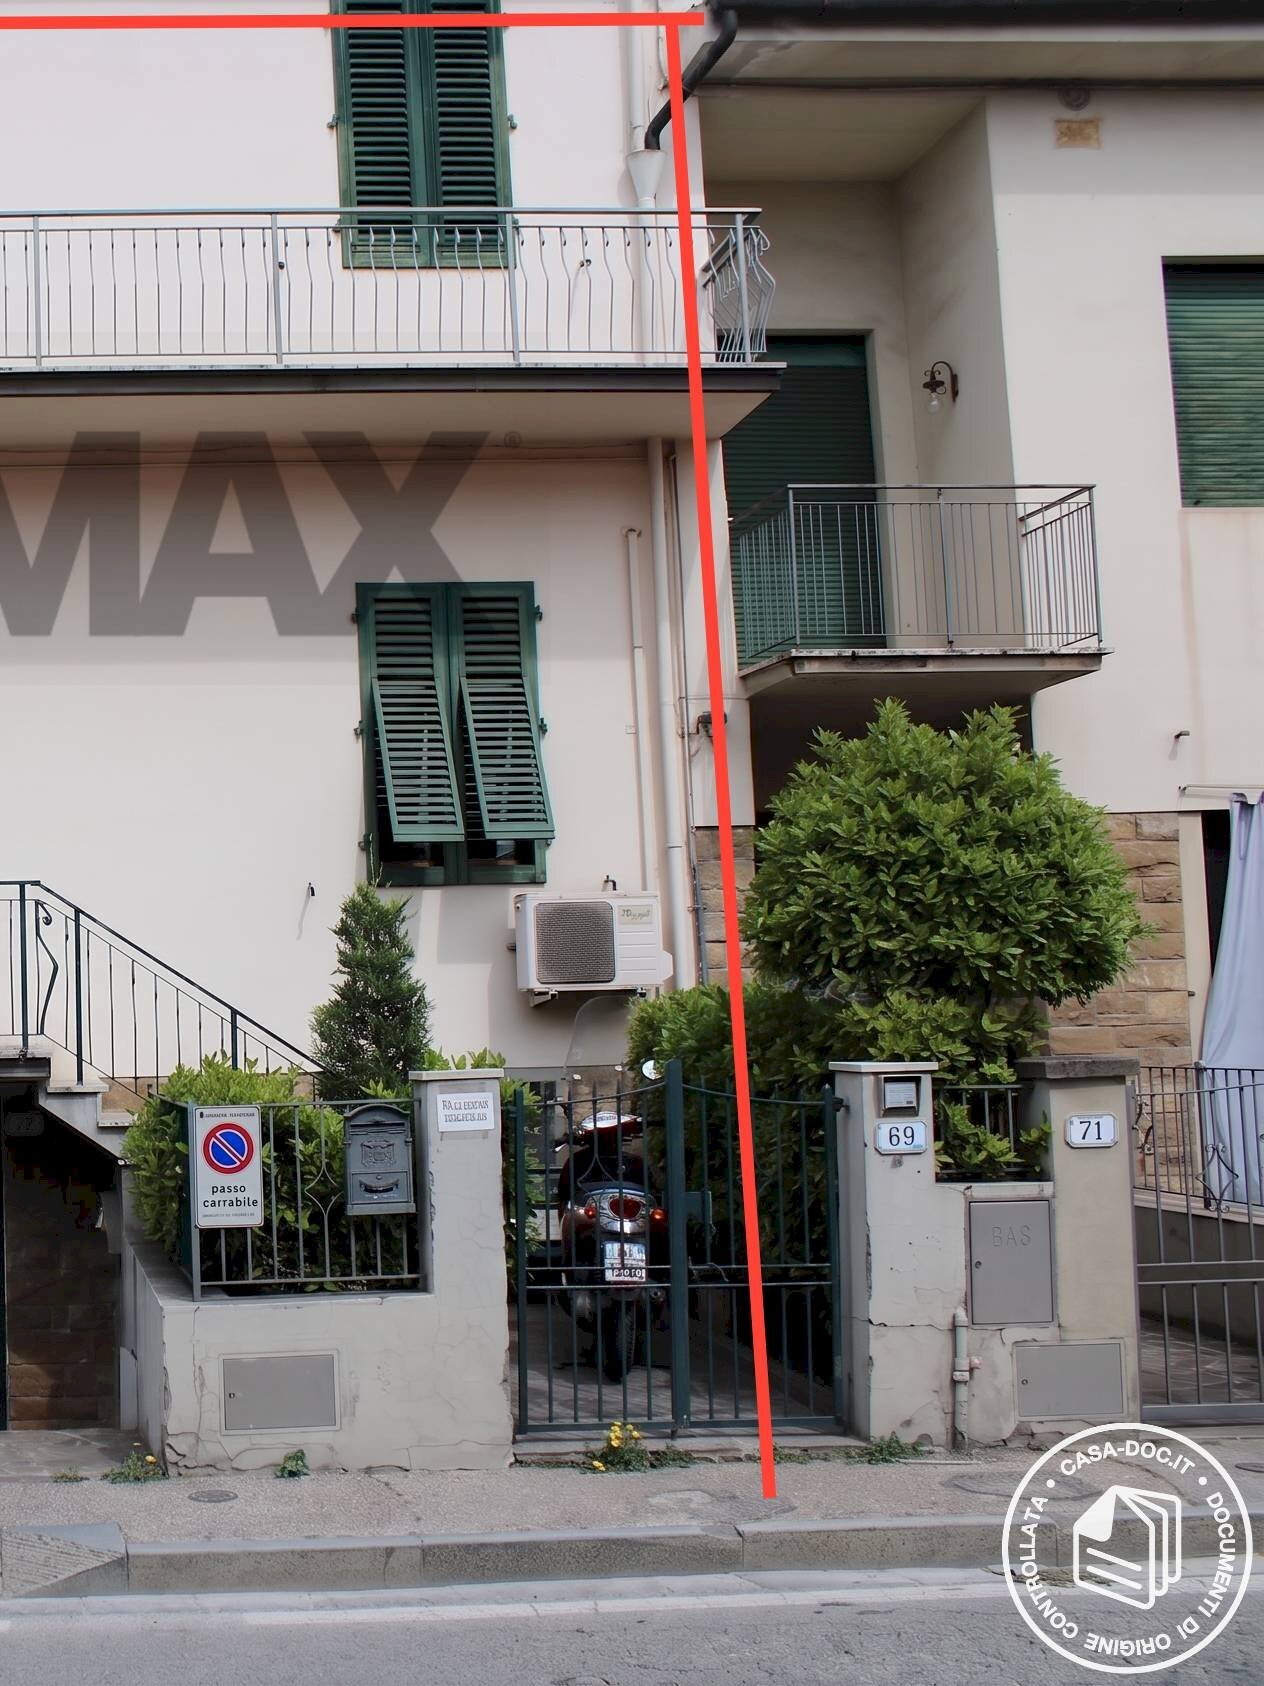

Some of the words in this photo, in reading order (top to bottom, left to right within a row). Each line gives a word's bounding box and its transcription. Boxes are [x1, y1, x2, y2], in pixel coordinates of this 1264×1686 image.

[889, 1126, 915, 1146] 69
[1079, 1120, 1102, 1140] 71
[211, 1185, 246, 1196] passo
[203, 1197, 258, 1208] carrabile
